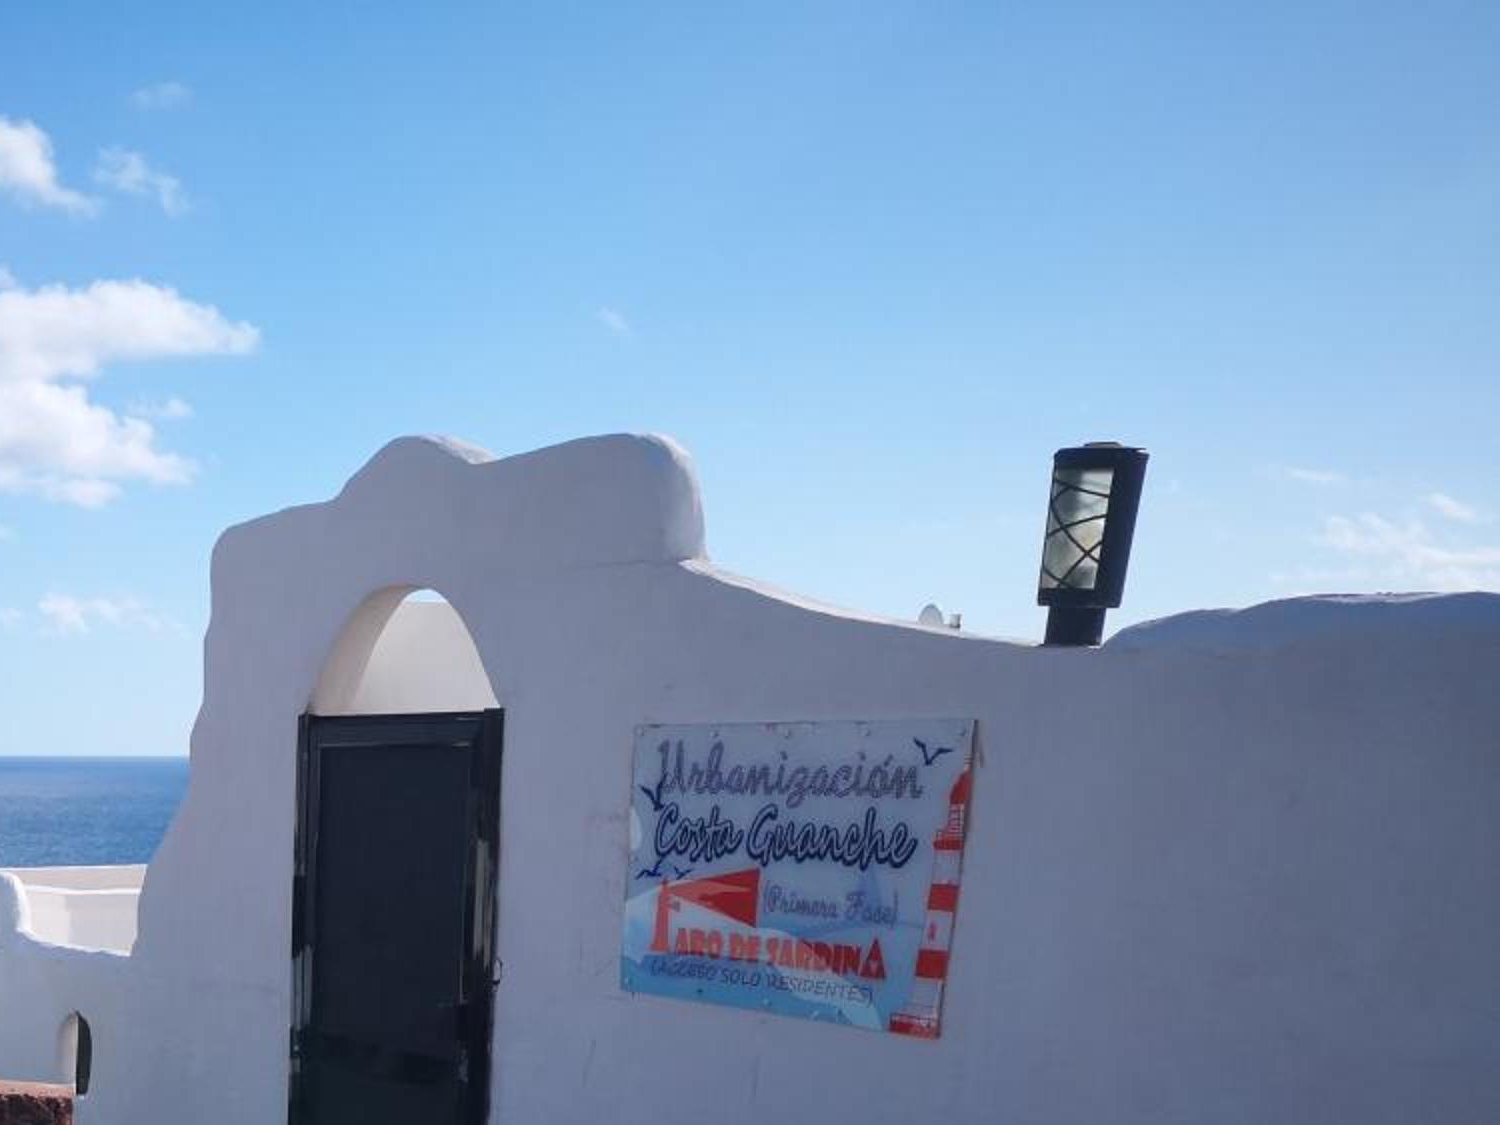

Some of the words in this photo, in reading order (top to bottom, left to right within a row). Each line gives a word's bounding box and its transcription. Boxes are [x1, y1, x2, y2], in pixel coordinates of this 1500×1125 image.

[657, 739, 923, 808] Urbanización
[656, 801, 745, 863] Costa
[746, 803, 919, 872] Guanche
[719, 963, 761, 989] SOLO
[728, 931, 762, 964] DE
[765, 934, 887, 981] SARDINA
